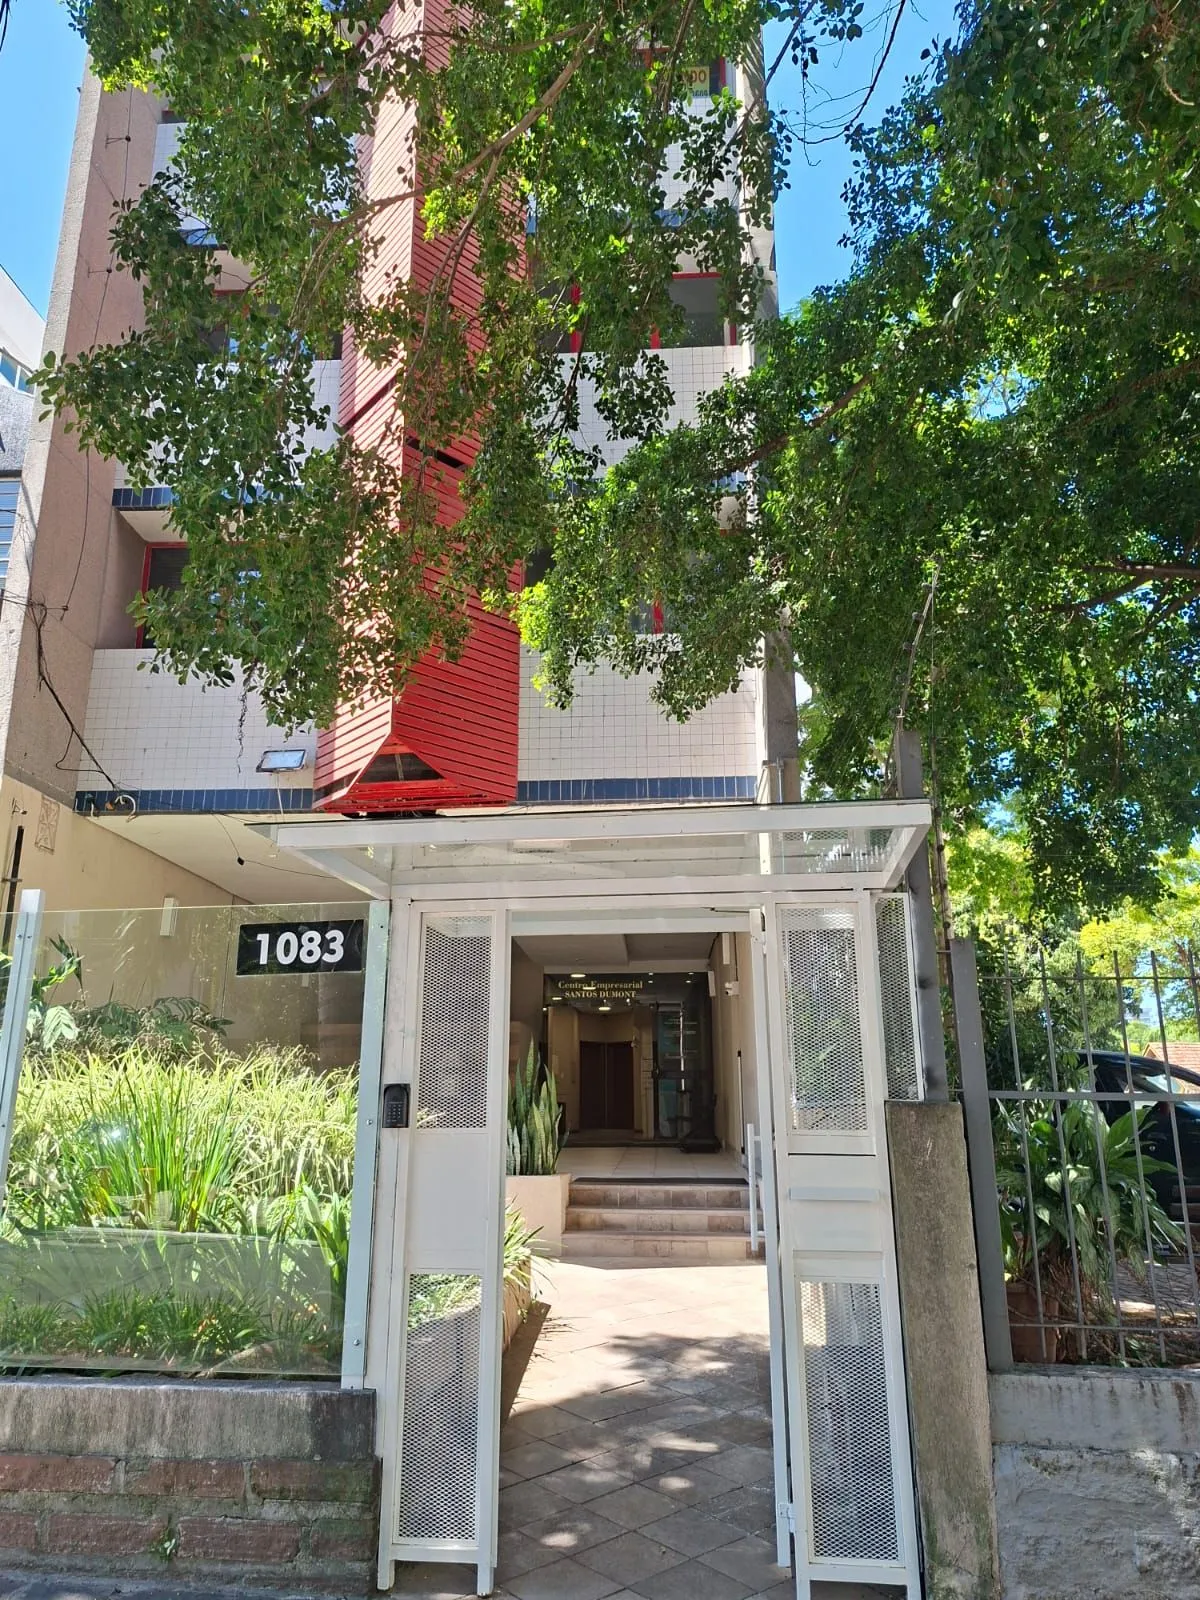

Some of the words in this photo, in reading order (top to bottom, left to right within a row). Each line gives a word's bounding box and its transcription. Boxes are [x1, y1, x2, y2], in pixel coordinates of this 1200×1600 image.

[256, 929, 345, 965] 1083
[558, 980, 588, 989] Centro
[591, 980, 643, 990] Empresarial
[564, 990, 598, 998] SANTOS
[600, 990, 636, 998] DUMONT
